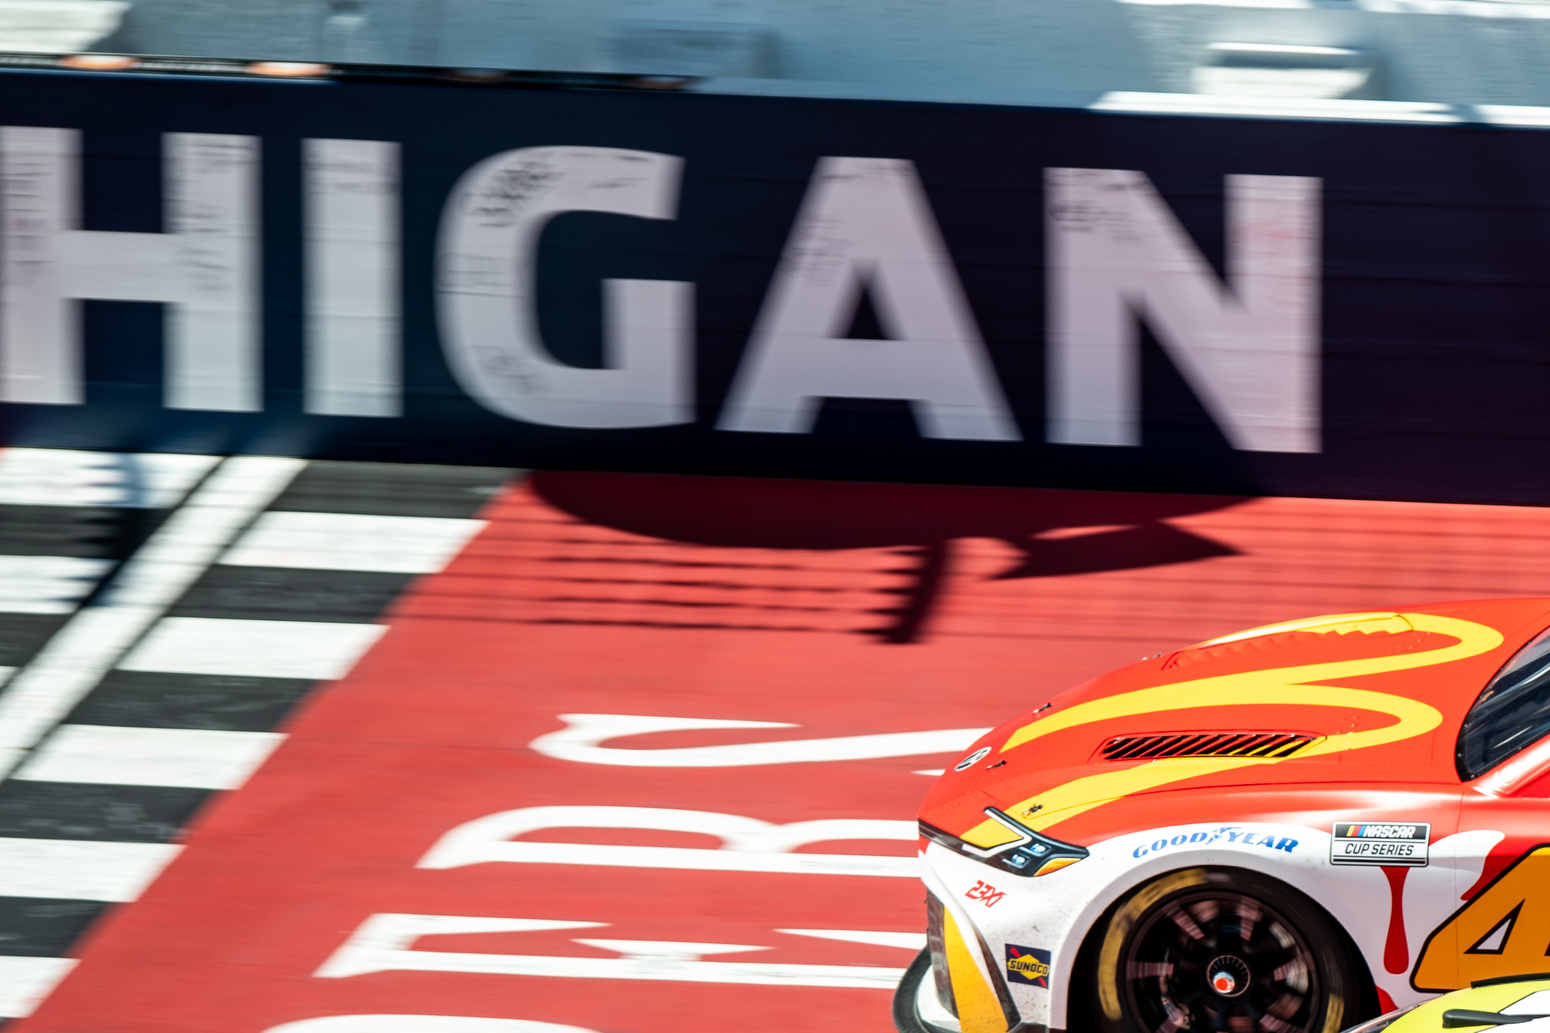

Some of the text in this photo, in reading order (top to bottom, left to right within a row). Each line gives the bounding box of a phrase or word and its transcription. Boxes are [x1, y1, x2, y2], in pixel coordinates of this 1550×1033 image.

[1363, 824, 1416, 838] NASCAR
[1345, 843, 1414, 856] CUP SERIES
[1010, 960, 1049, 976] SUNOCO
